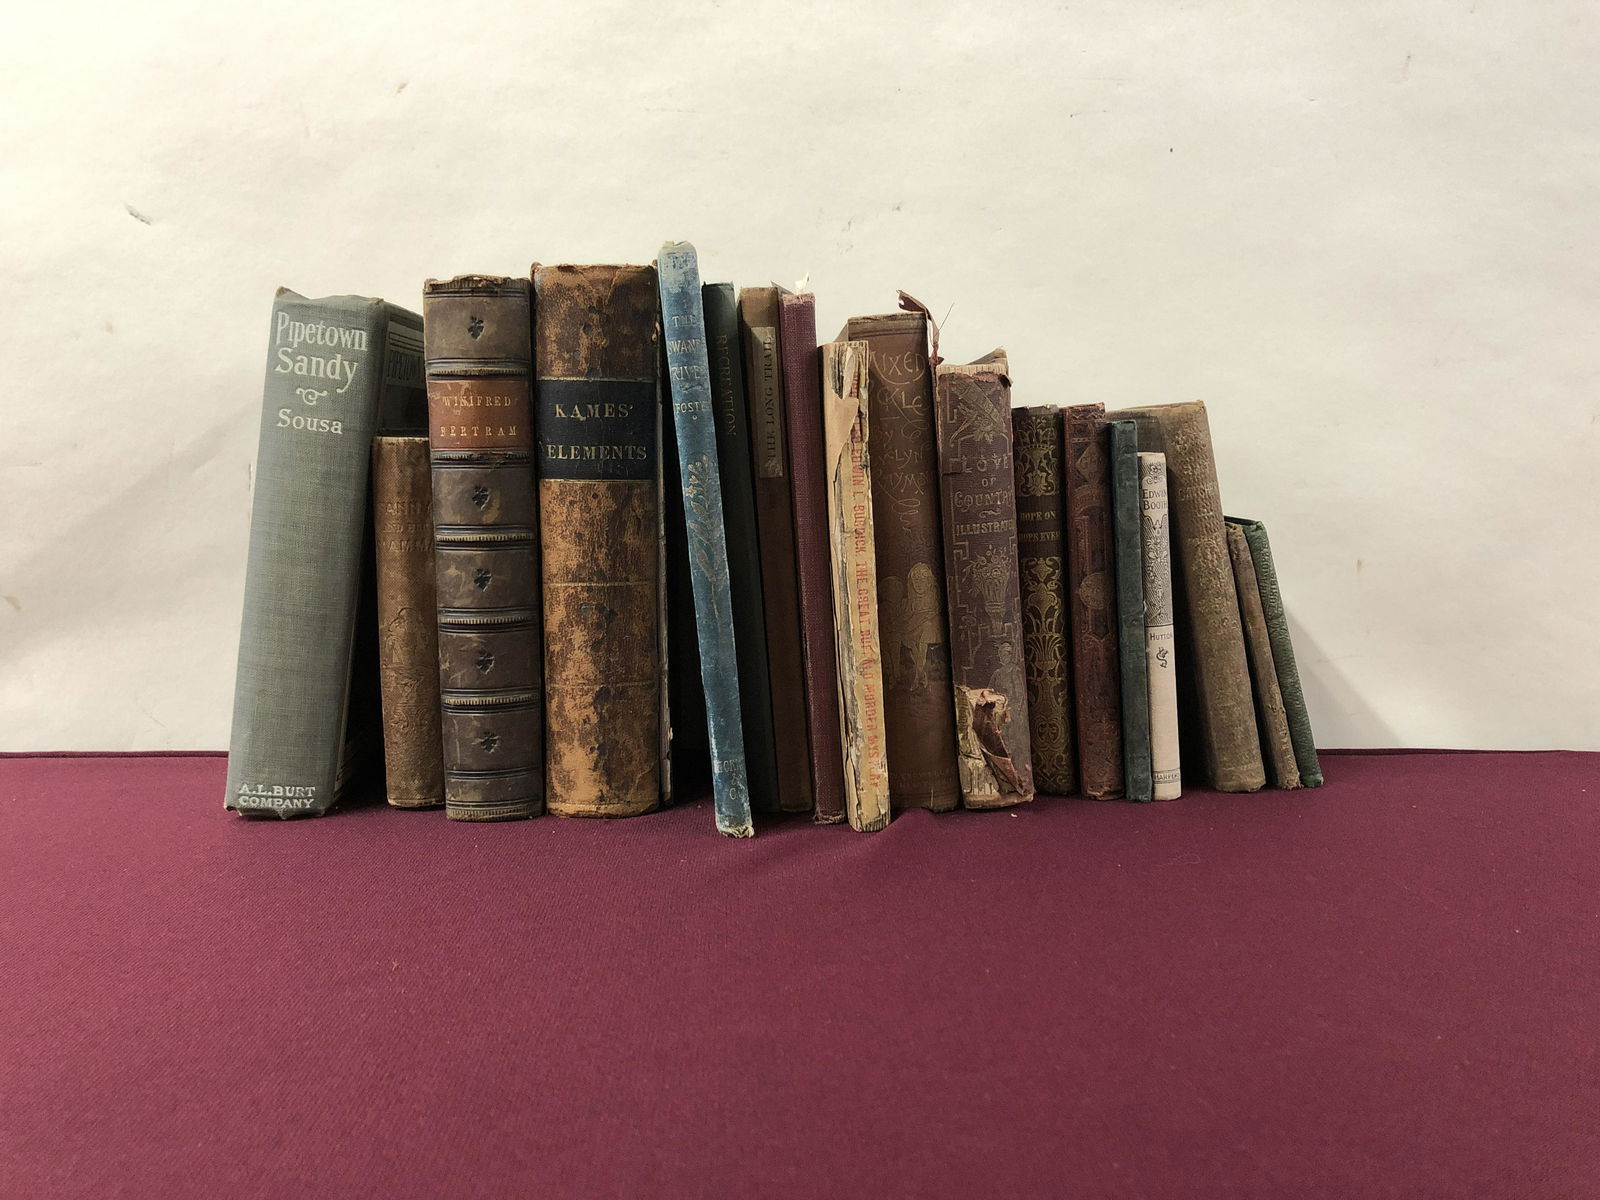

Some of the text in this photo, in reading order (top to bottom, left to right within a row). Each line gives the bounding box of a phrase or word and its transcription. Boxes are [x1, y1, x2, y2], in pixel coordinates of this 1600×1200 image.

[276, 311, 368, 351] Pipetown
[275, 347, 358, 393] Sandy
[442, 395, 512, 407] WINIFRED
[762, 336, 776, 461] THE LONG TRAIL
[277, 408, 343, 434] Sousa
[555, 403, 634, 419] KAMES'
[440, 425, 517, 437] BERTRAM
[546, 444, 647, 460] ELEMENTS
[953, 518, 1015, 536] ILLUSTRATE
[855, 560, 868, 584] THE
[857, 587, 871, 626] GREAT
[239, 795, 315, 808] COMPANY
